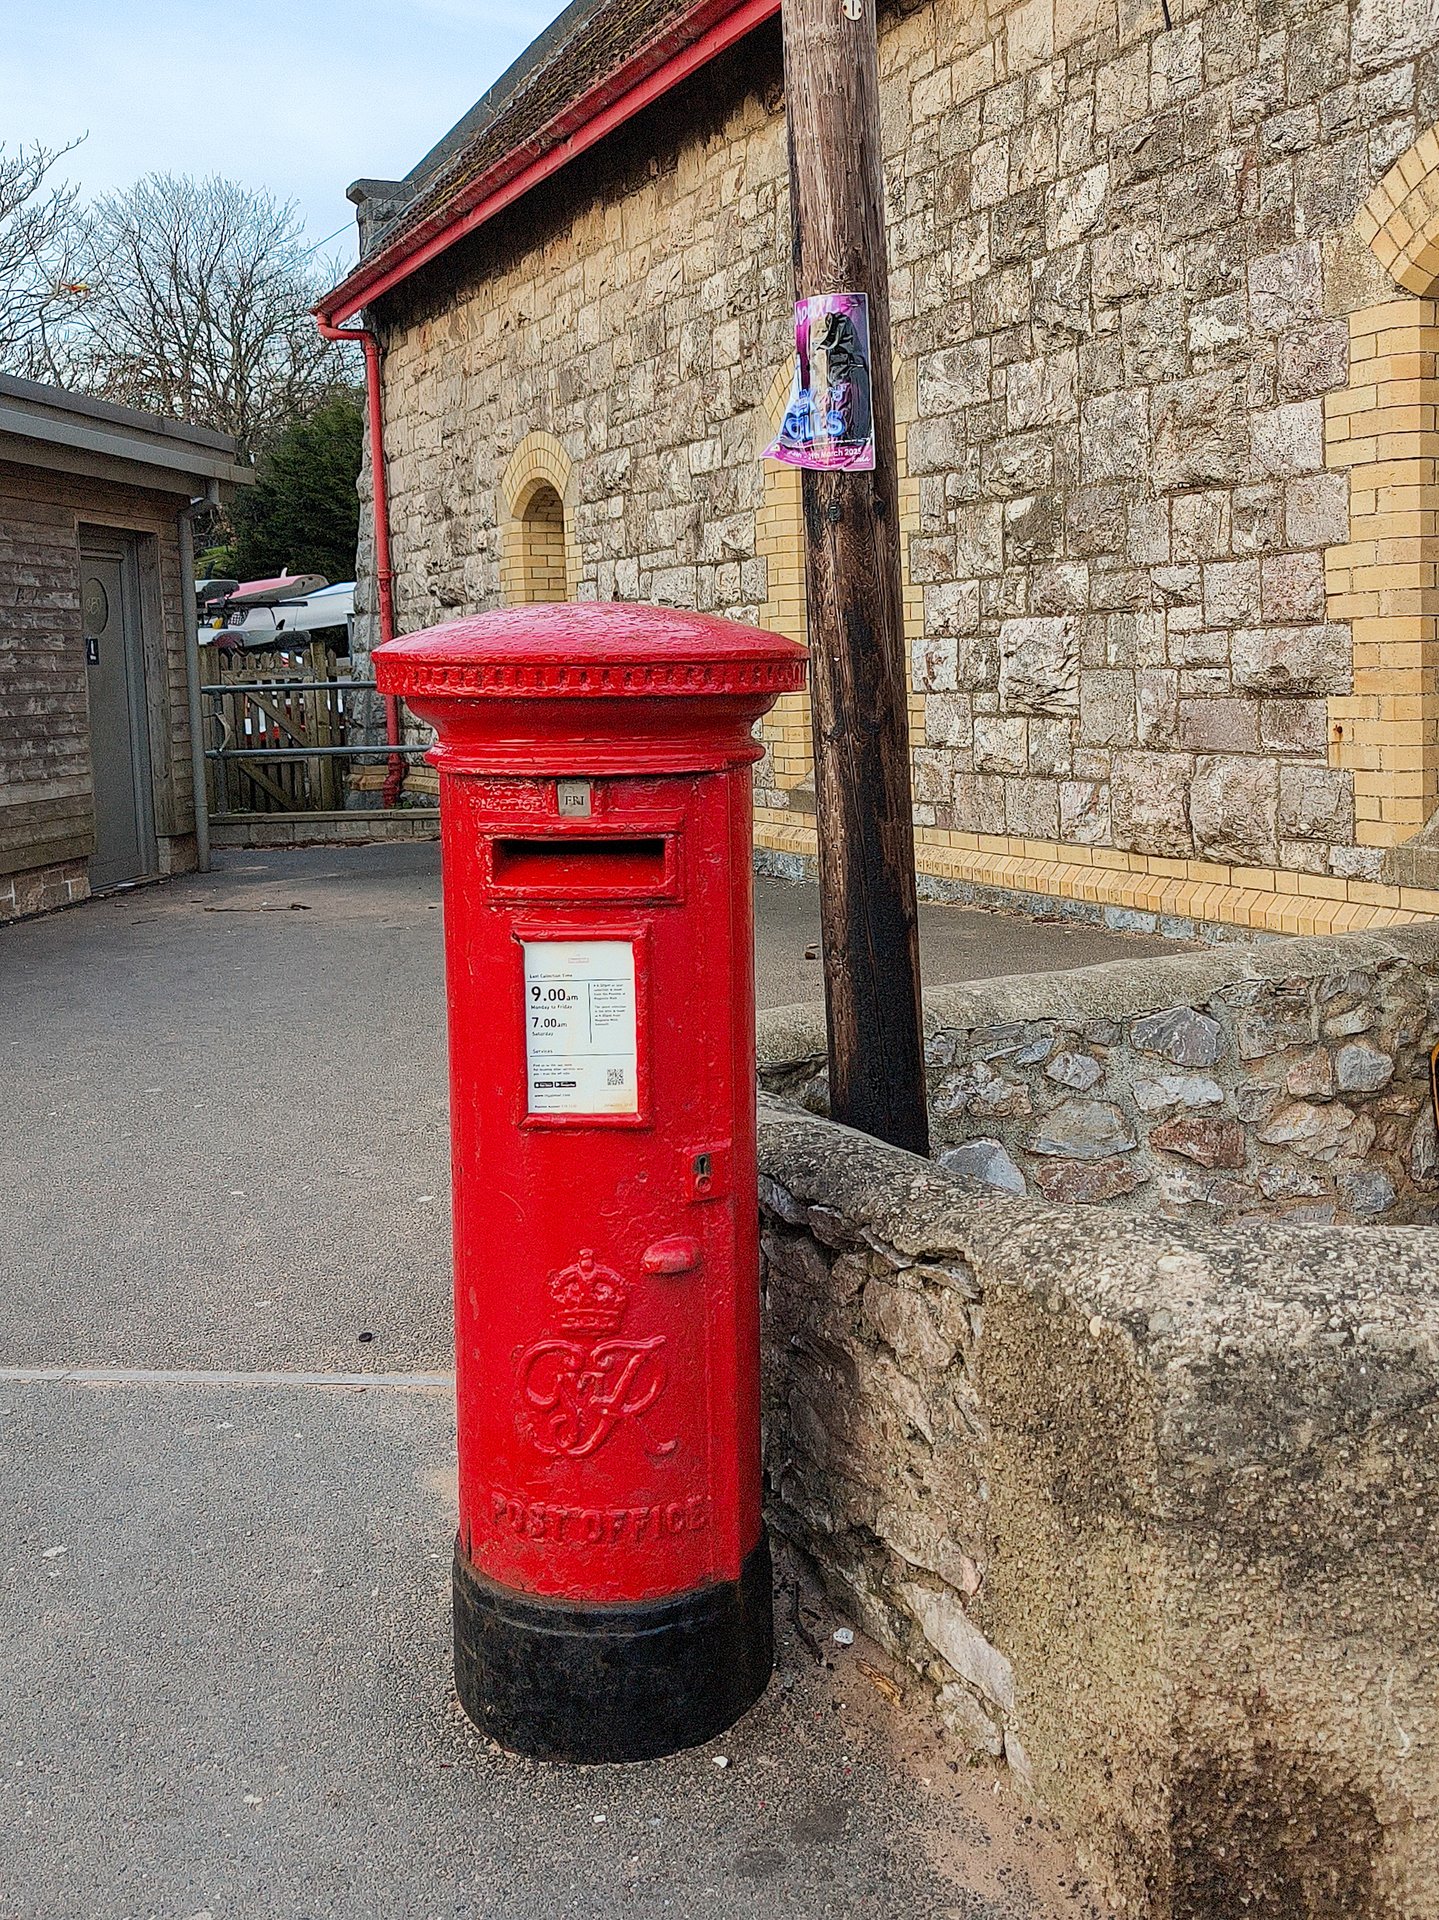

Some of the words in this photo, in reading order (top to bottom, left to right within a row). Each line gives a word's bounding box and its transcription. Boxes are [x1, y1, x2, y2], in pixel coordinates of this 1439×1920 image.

[565, 795, 585, 806] FRI
[531, 986, 579, 1002] 9.00am
[531, 1016, 568, 1028] 7.00am
[490, 1491, 579, 1543] POST
